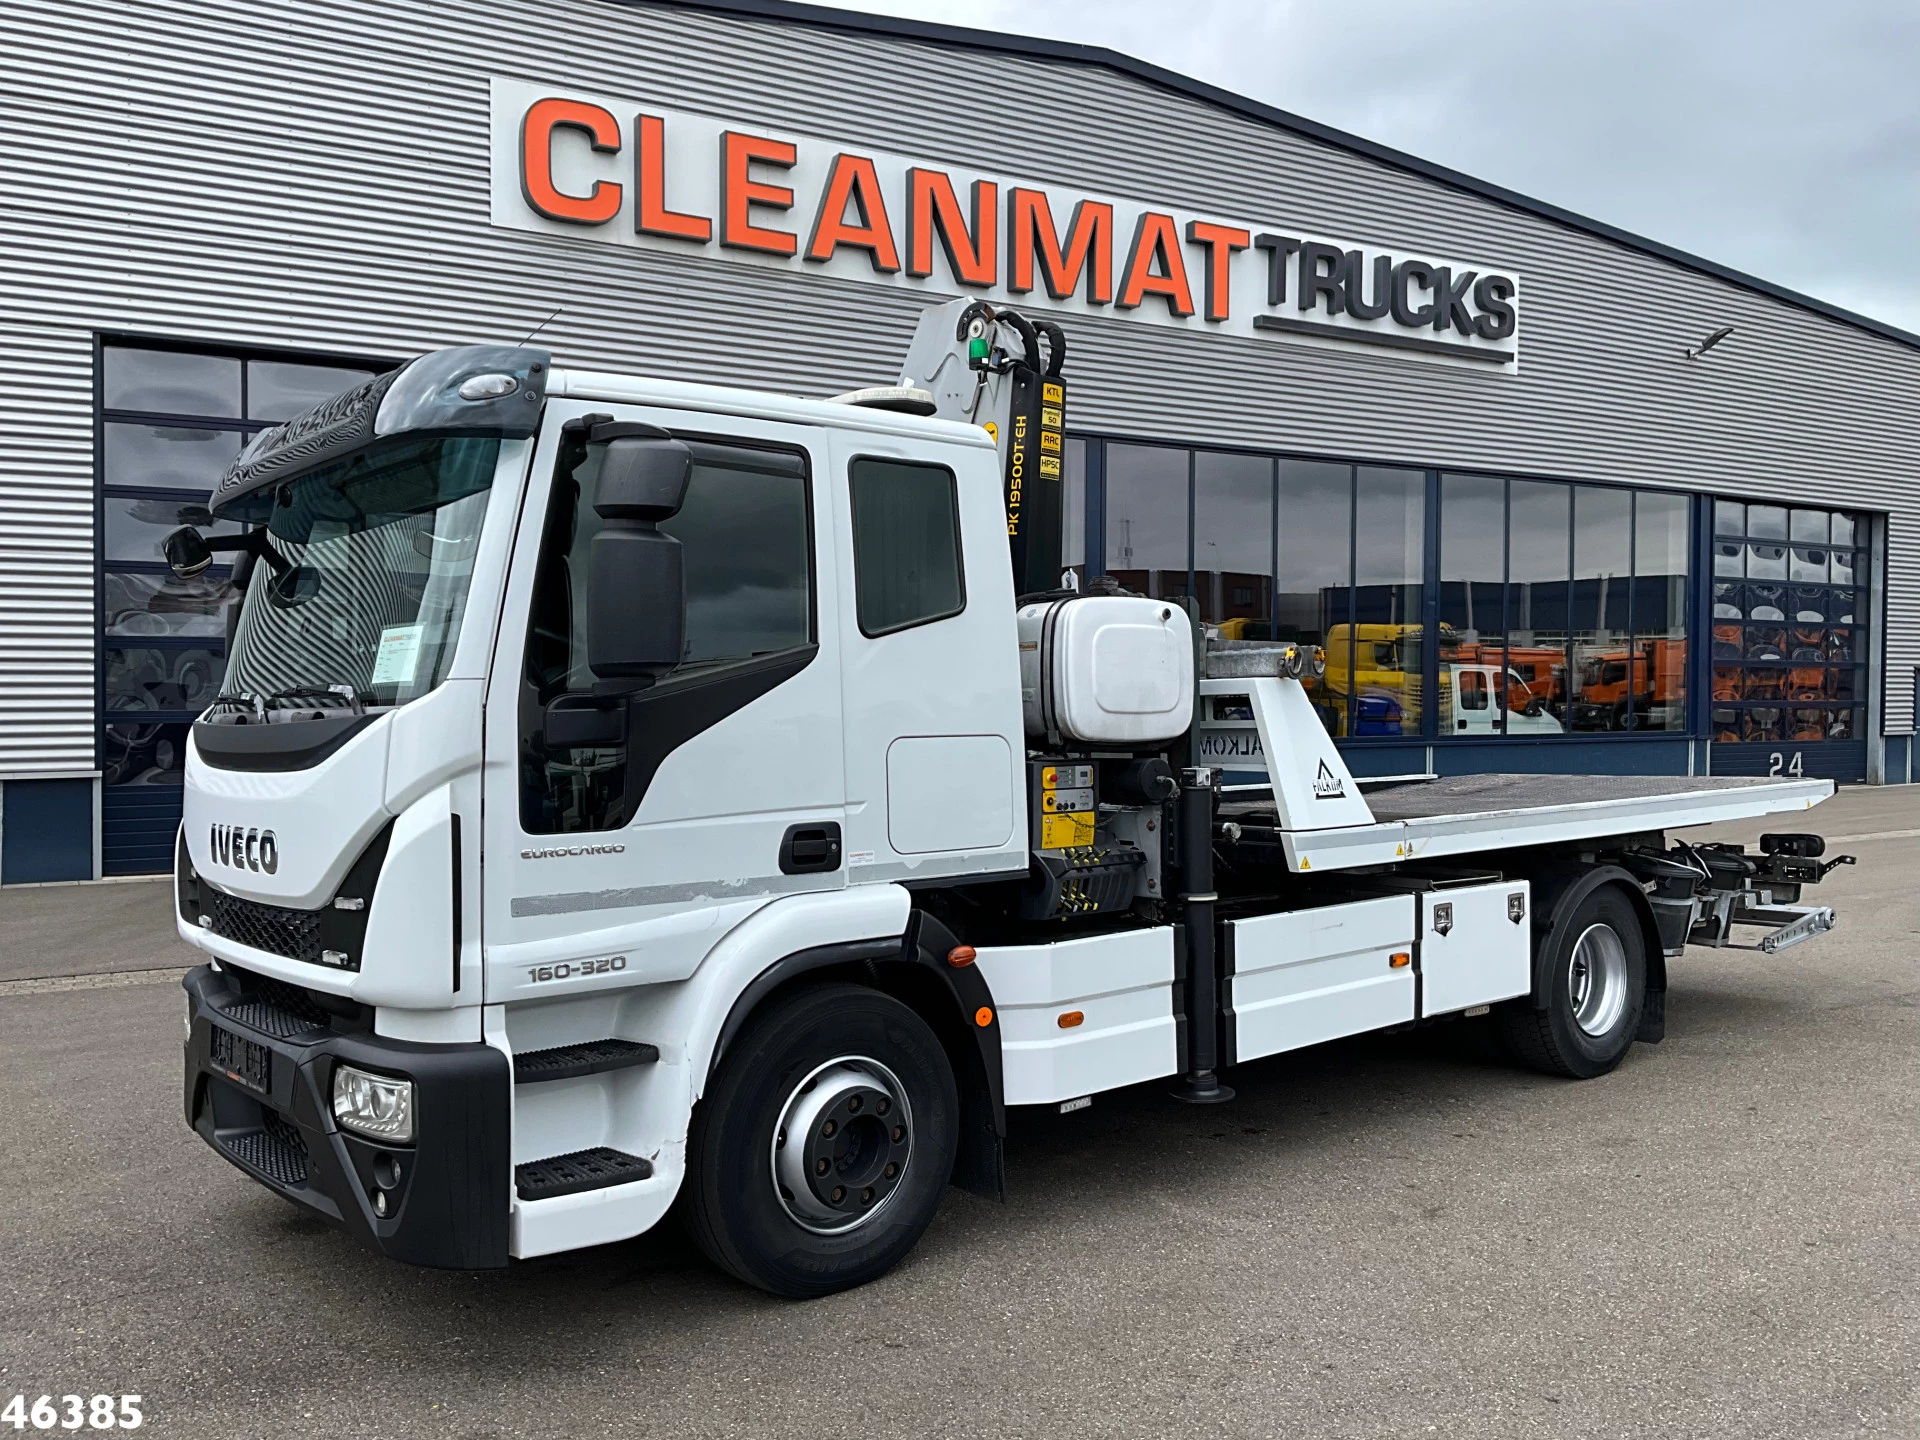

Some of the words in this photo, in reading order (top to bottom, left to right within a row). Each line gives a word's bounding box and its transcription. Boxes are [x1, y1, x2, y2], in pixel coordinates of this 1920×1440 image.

[519, 97, 1250, 322] CLEANMAT
[1254, 233, 1515, 340] TRUCKS
[1048, 416, 1057, 424] 50
[1008, 513, 1019, 536] PK
[1769, 751, 1803, 778] 24
[210, 823, 278, 875] IVECO
[520, 843, 625, 859] EUROCARGO
[528, 956, 626, 983] 160-320
